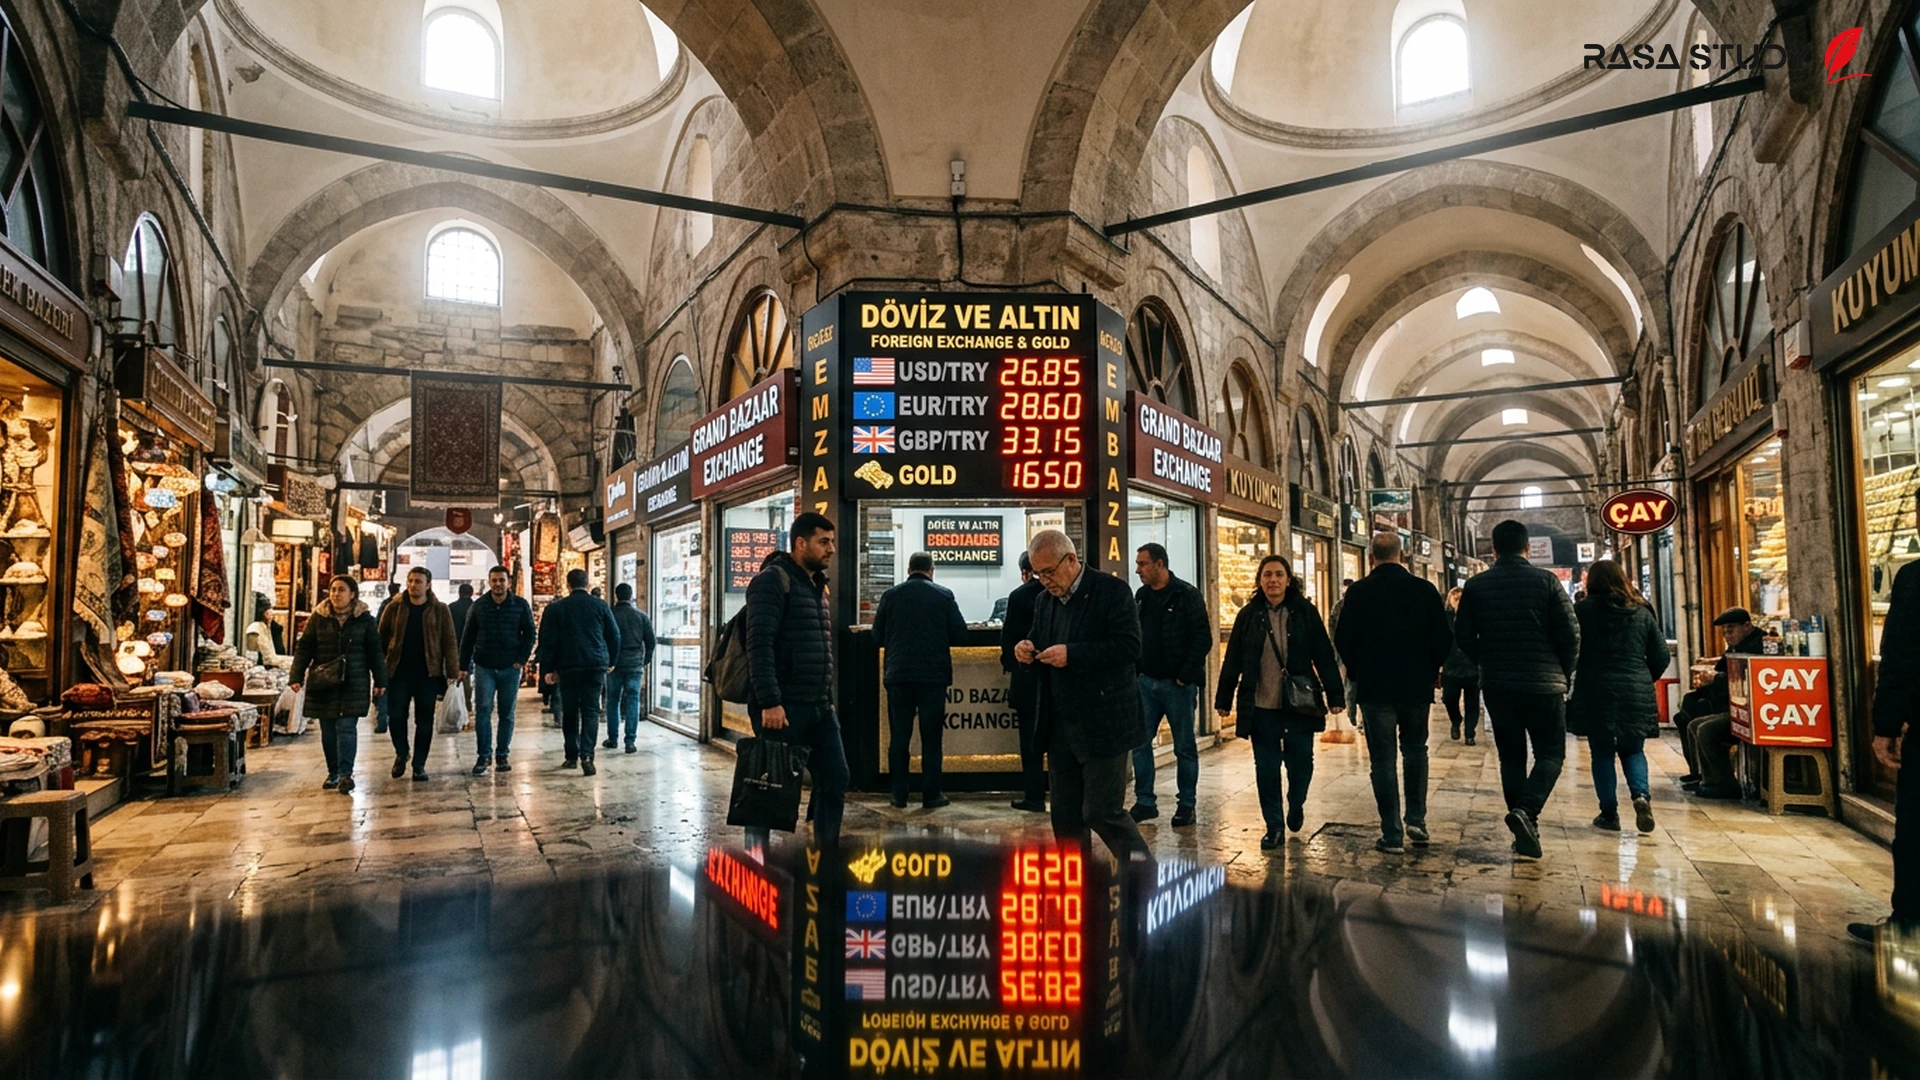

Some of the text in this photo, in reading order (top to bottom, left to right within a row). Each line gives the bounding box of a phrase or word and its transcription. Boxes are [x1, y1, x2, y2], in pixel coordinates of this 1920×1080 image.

[861, 298, 1080, 330] DÖVİZ VE ALTIN
[871, 335, 1070, 350] FOREIGN EXCHANGE & GOLD
[899, 358, 1081, 387] USD/TRY 26.85
[693, 384, 779, 455] GRAND BAZAAR
[899, 392, 1082, 420] EUR/TRY 28.60
[899, 426, 1081, 454] GBP/TRY 33.15
[1140, 404, 1222, 464] GRAND BAZAAR
[703, 433, 764, 486] EXCHANGE
[1154, 447, 1212, 493] EXCHANGE
[899, 461, 1082, 489] GOLD 1650
[1230, 468, 1284, 510] KUYUMCU
[1609, 500, 1667, 529] ÇAY
[1757, 667, 1821, 695] ÇAY
[1759, 703, 1822, 731] ÇAY
